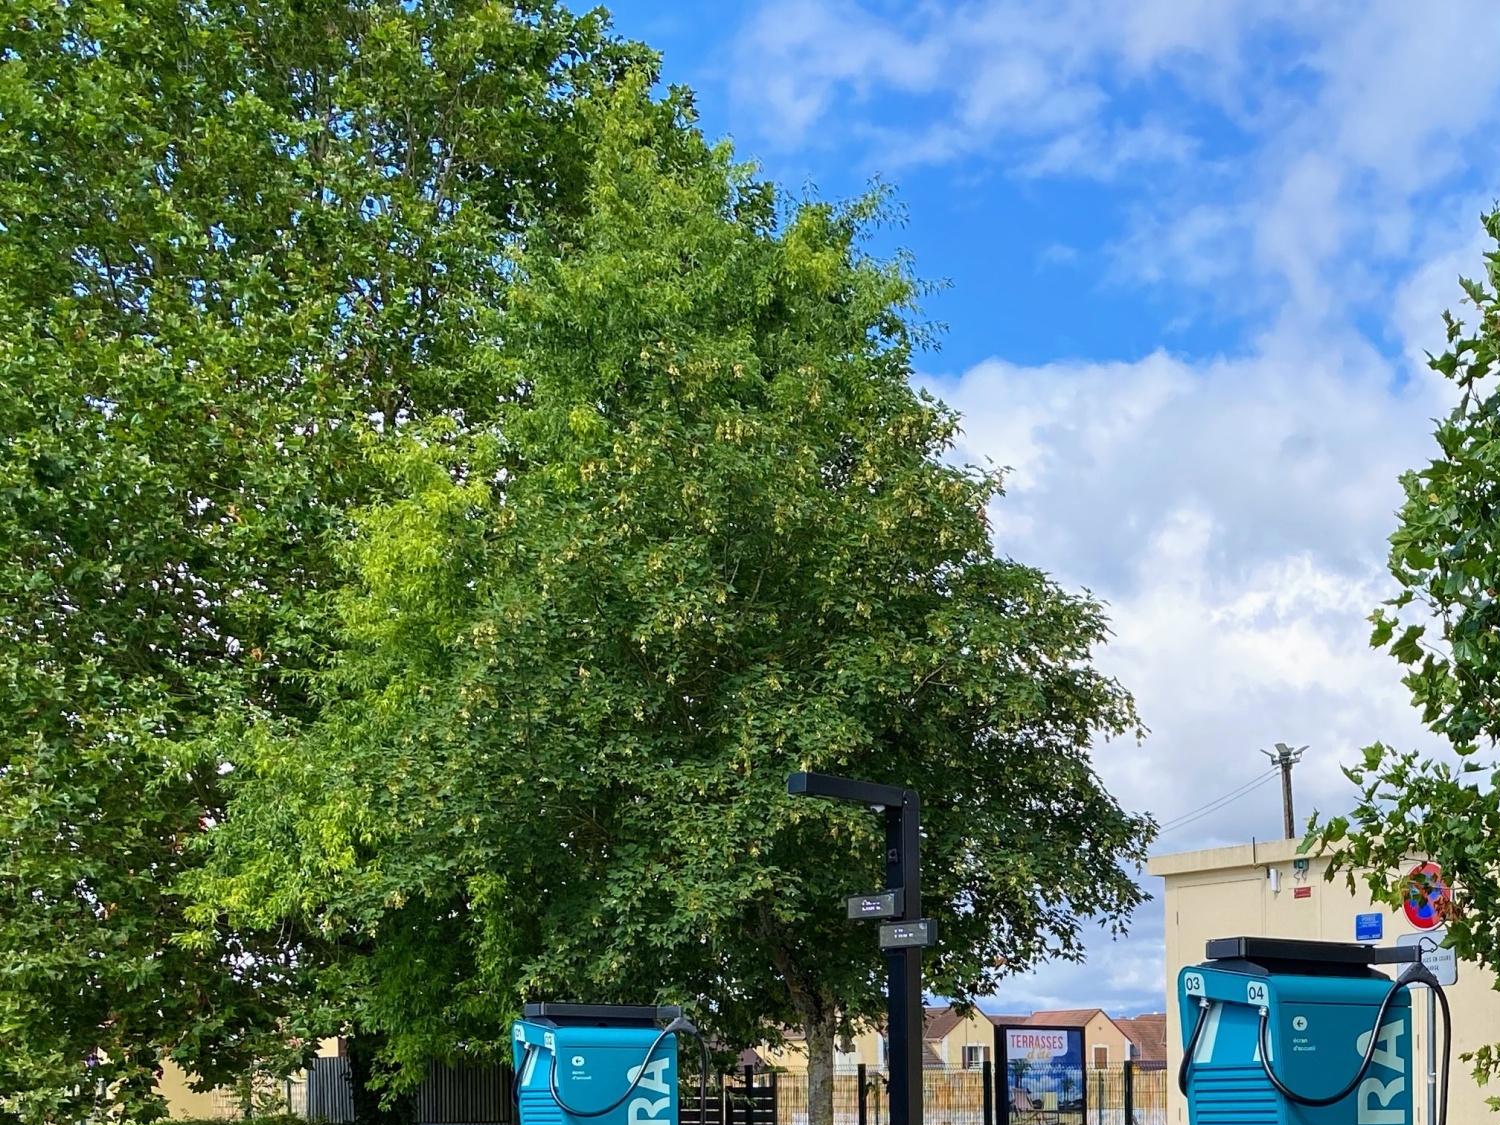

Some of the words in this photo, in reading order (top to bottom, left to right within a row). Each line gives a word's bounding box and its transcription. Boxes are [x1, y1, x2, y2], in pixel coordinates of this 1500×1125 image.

[1186, 977, 1200, 991] 03
[1249, 986, 1264, 1000] 04
[1010, 1034, 1064, 1050] TERRASSES
